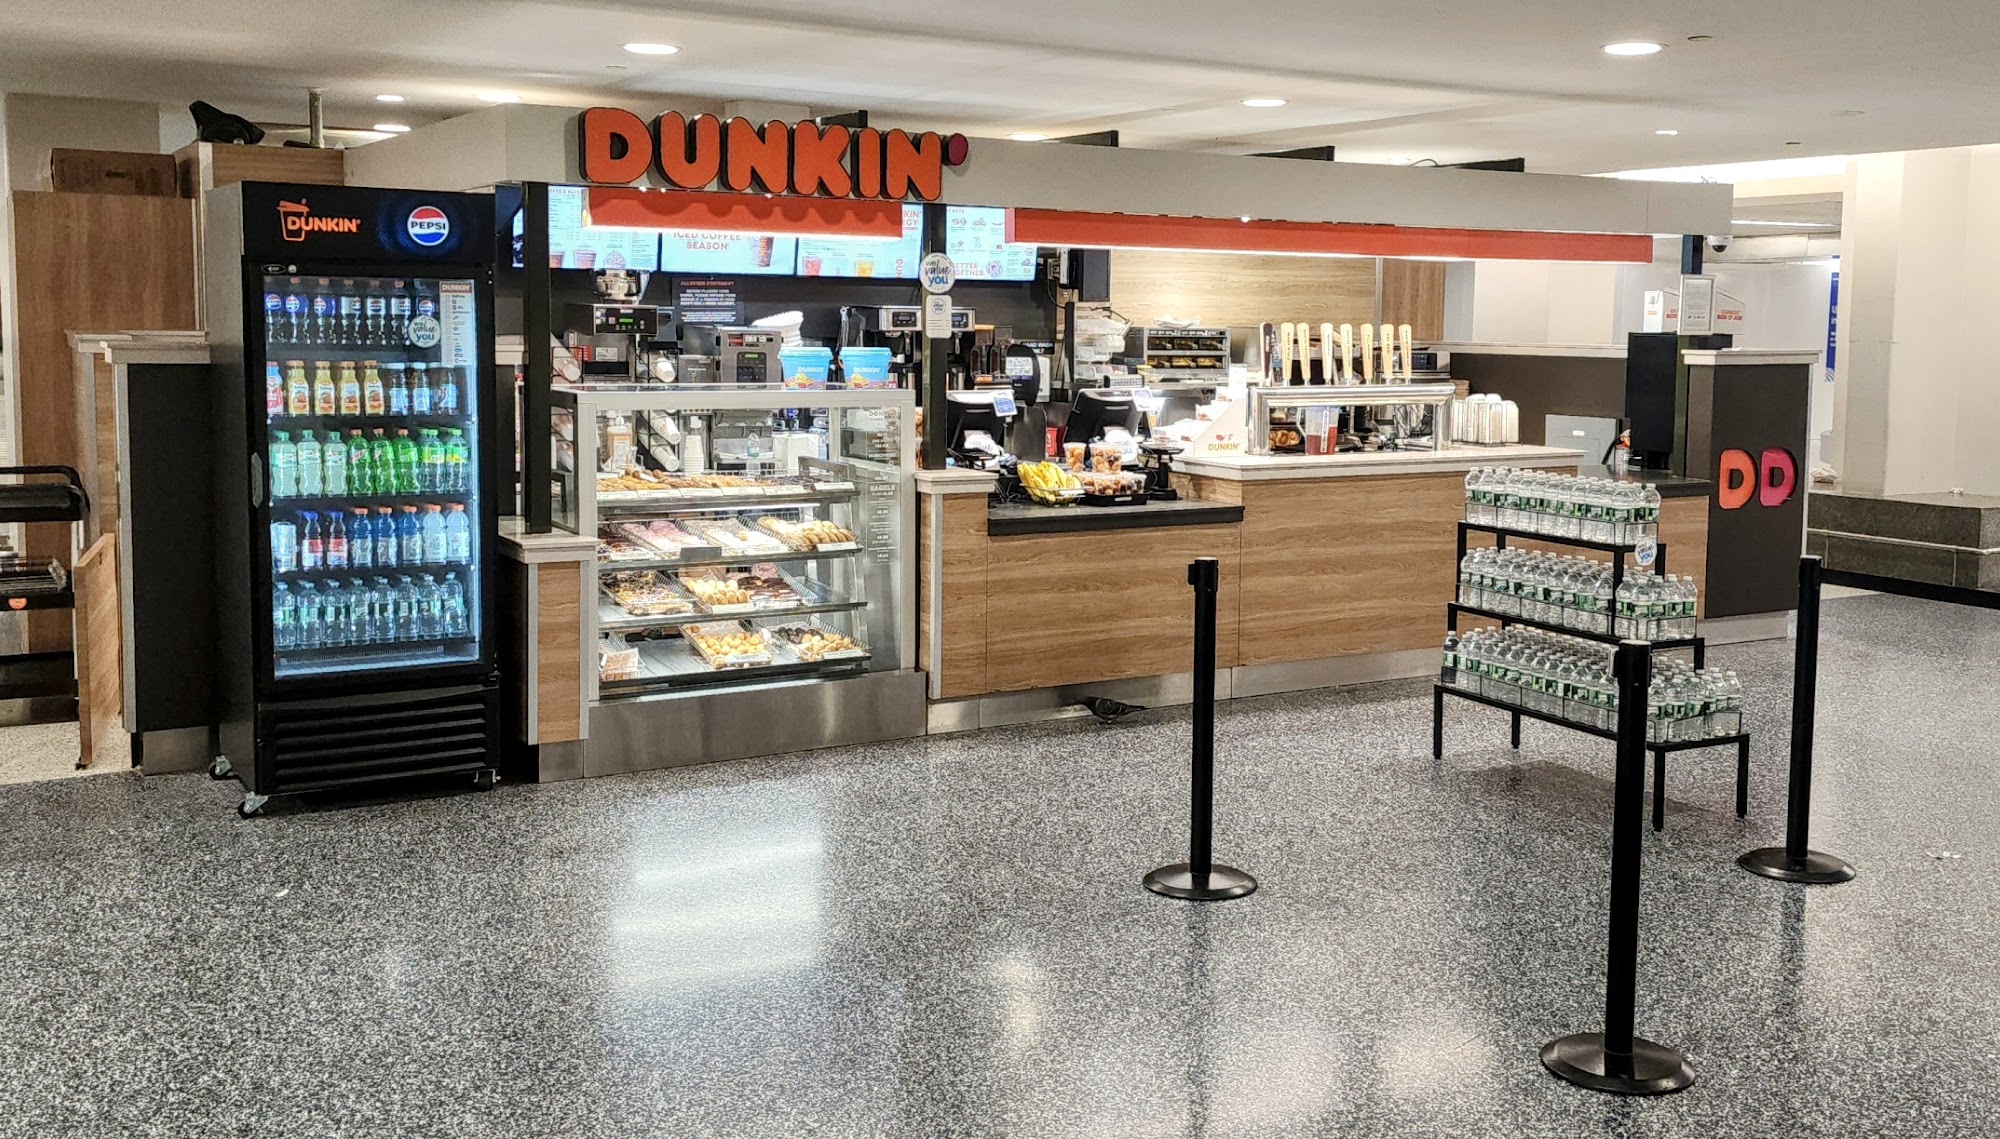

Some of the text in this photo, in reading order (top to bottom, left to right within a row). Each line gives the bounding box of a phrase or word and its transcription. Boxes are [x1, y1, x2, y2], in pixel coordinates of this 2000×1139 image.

[580, 107, 969, 200] DUNKIN'
[287, 216, 361, 232] DUNKIN'
[411, 222, 446, 230] PEPSI
[687, 242, 728, 250] SEASON
[925, 260, 951, 276] value
[928, 276, 948, 287] you
[413, 320, 437, 334] value
[416, 334, 434, 342] you
[1208, 443, 1240, 451] DUNKIN'
